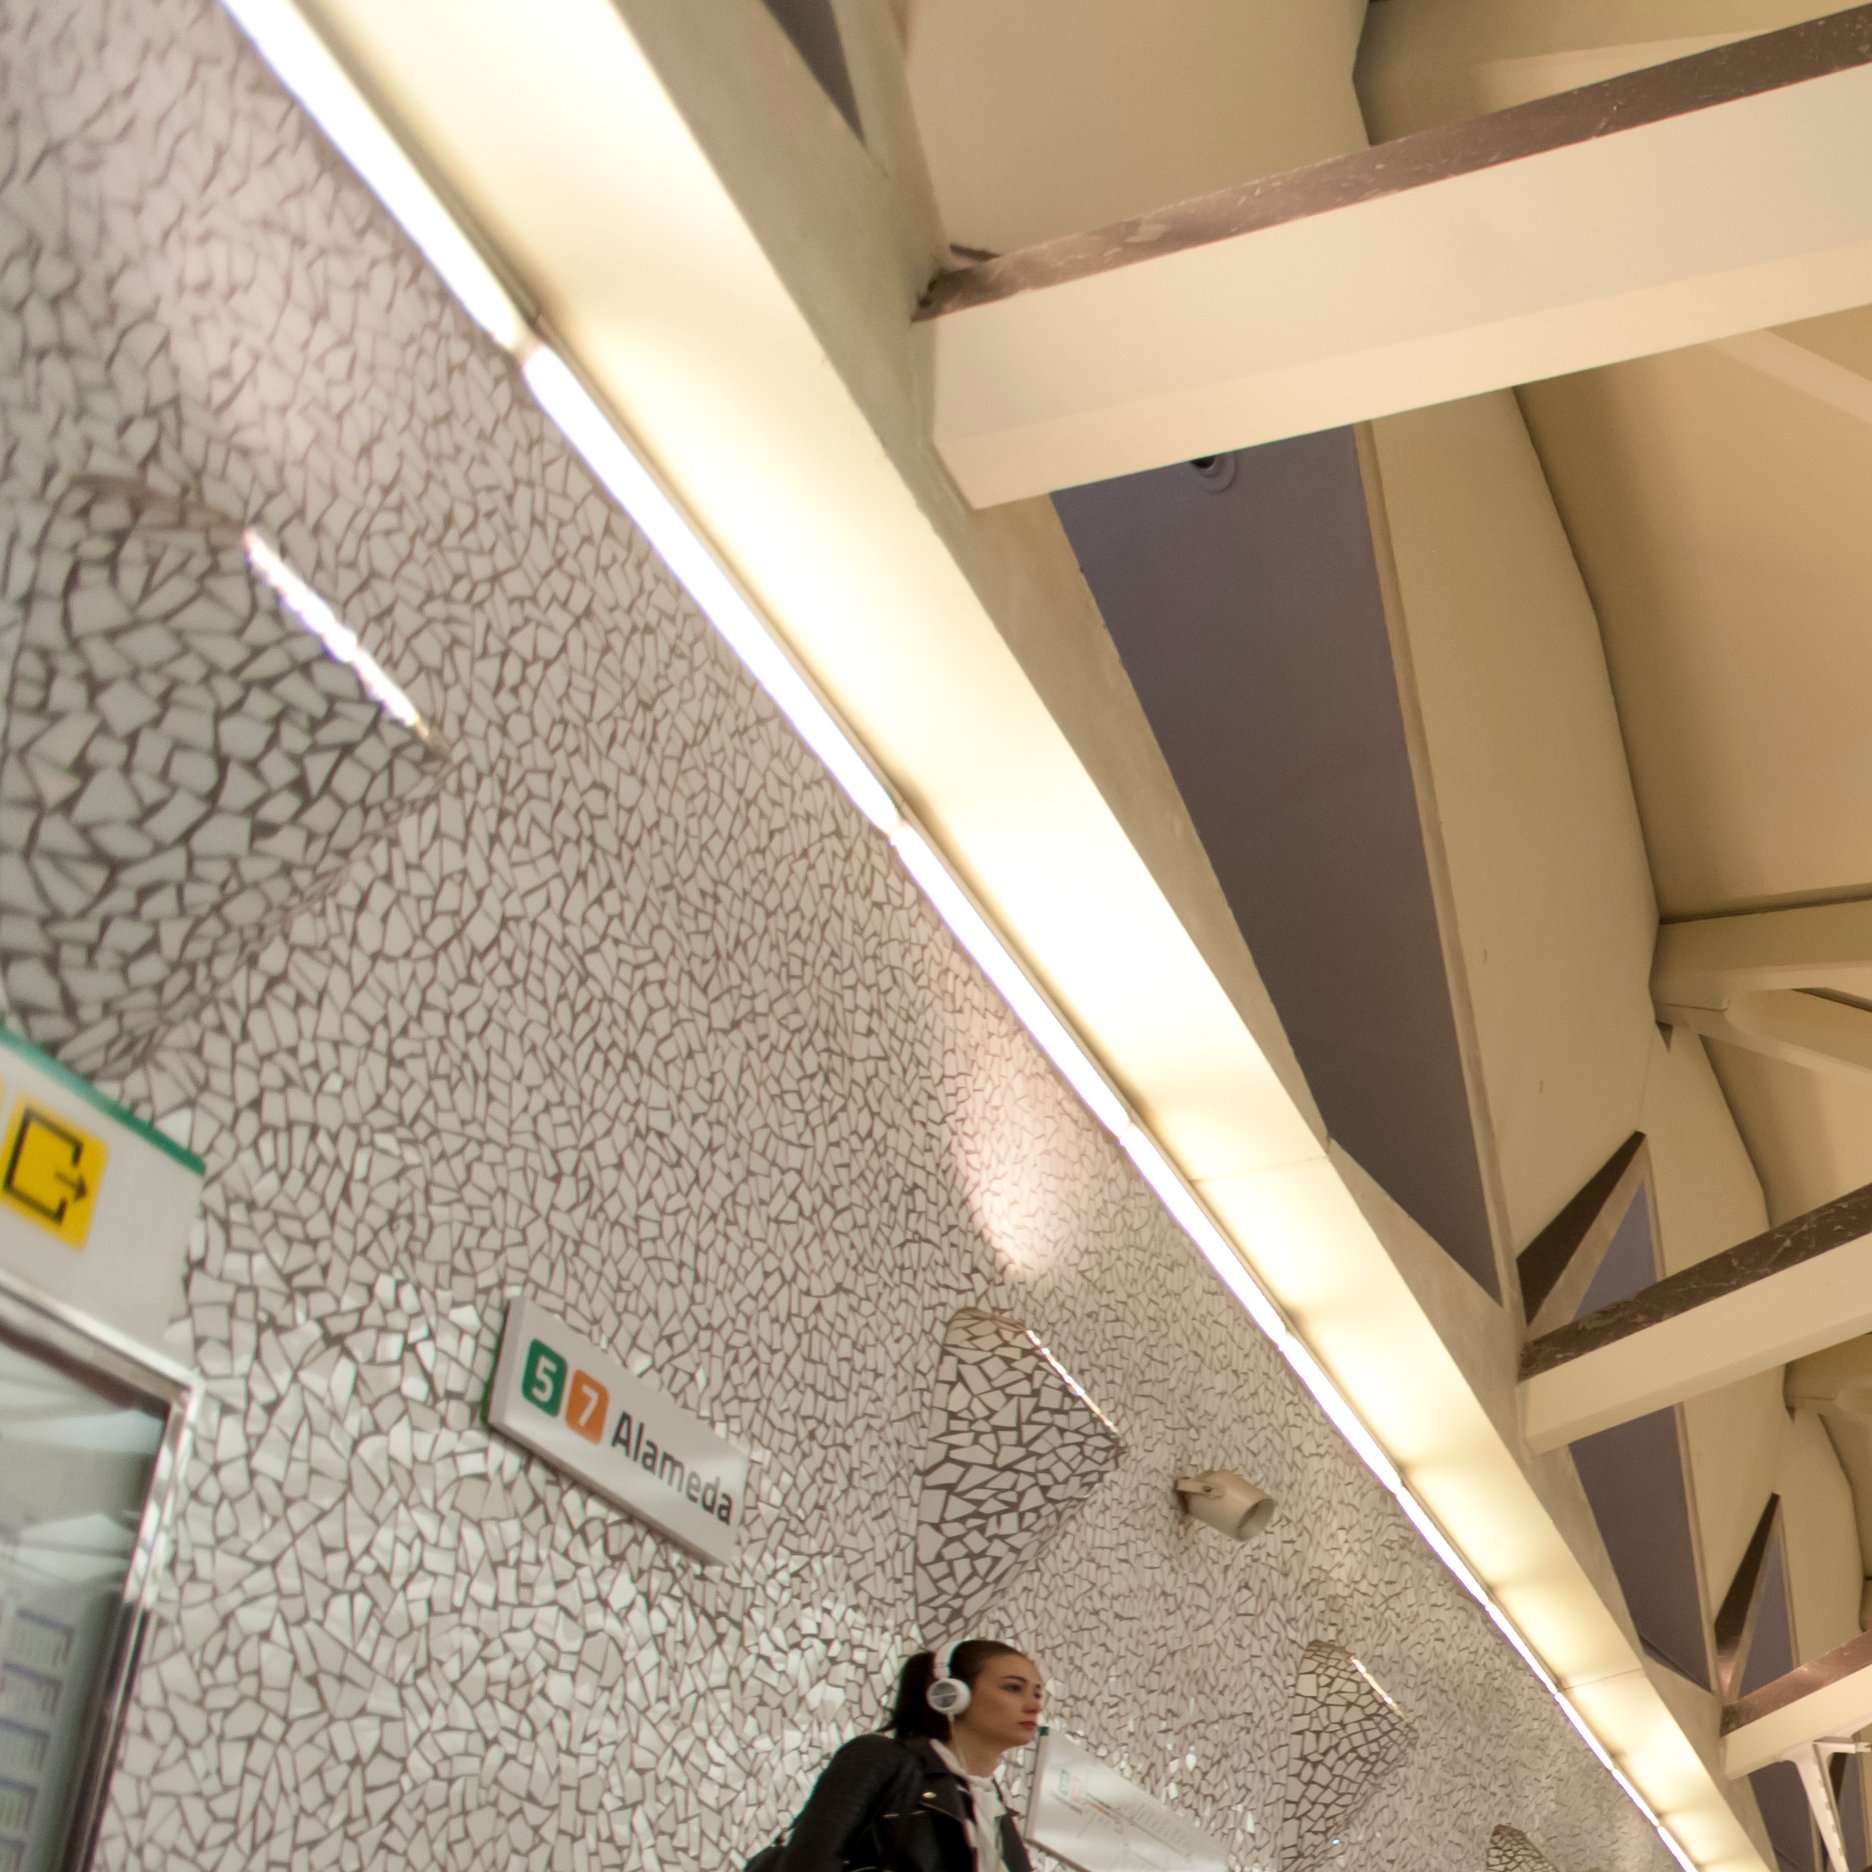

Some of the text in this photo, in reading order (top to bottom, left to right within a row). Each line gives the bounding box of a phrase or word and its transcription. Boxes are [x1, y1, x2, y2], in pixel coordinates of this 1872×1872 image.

[532, 1356, 733, 1525] 5 7 Alameda
